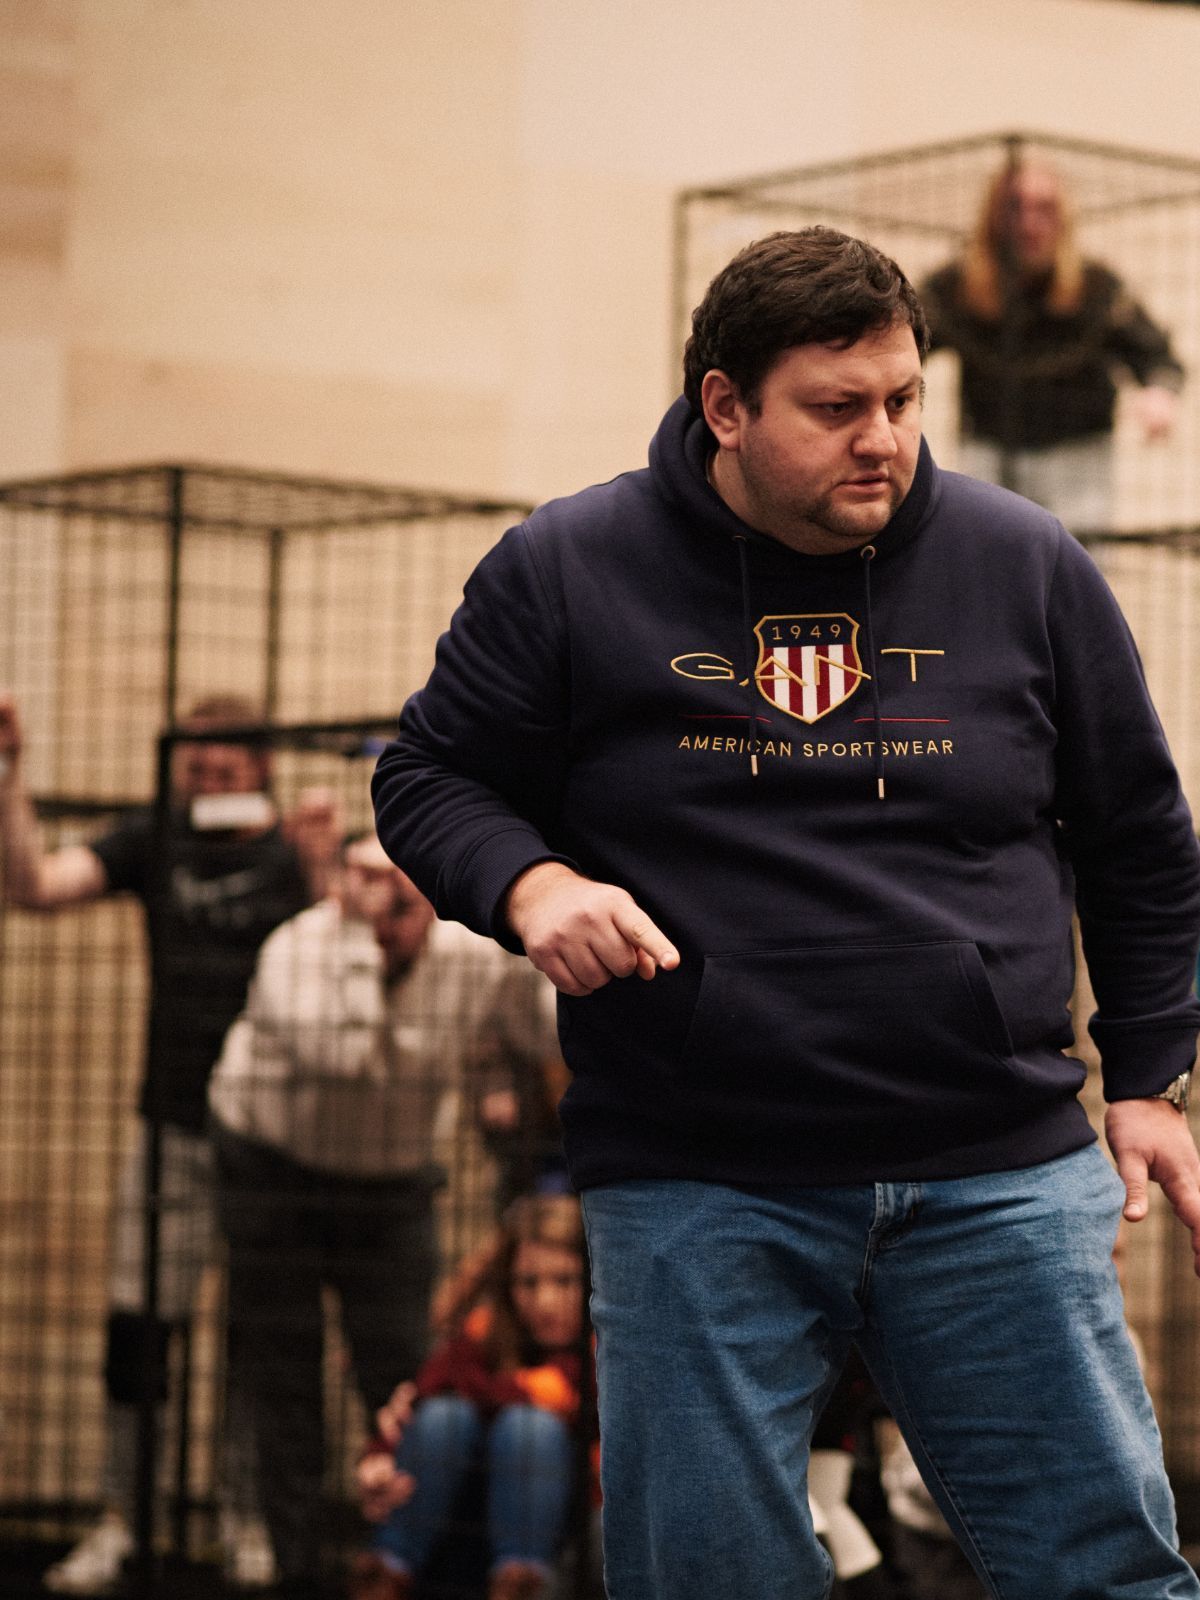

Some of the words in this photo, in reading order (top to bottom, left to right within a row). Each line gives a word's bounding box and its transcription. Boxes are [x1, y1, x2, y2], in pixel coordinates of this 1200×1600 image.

[772, 624, 841, 640] 1949
[678, 735, 792, 757] AMERICAN
[802, 740, 953, 758] SPORTSWEAR
